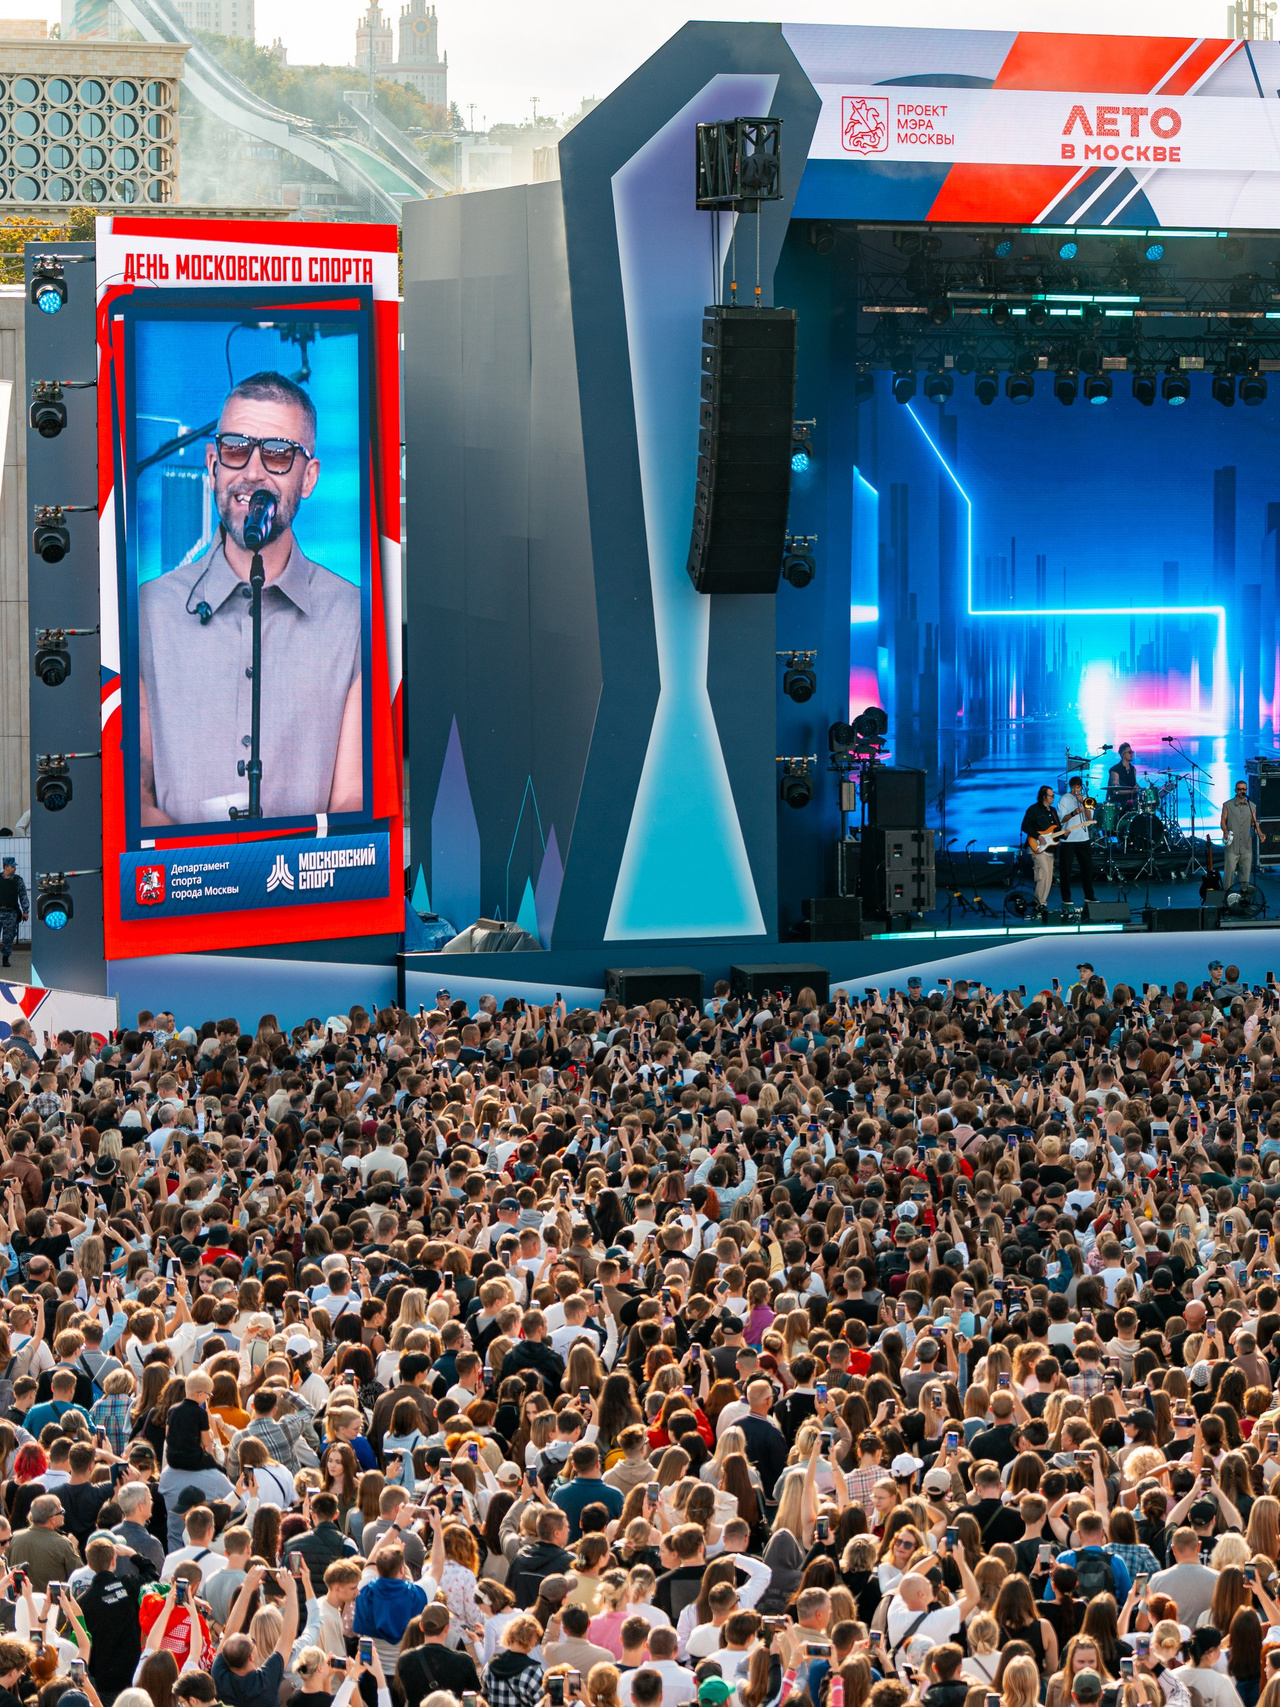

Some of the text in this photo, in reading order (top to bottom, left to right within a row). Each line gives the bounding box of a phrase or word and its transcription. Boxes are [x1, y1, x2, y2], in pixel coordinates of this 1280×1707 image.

[896, 104, 948, 118] ПРОЕКТ
[896, 119, 934, 132] МЭРА
[1061, 105, 1182, 139] ЛЕТО
[896, 132, 955, 145] МОСКВЫ
[1061, 144, 1181, 163] В МОСКВЕ
[123, 253, 373, 284] ДЕНЬ МОСКОВСКОГО СПОРТА
[298, 843, 376, 871] МОСКОВСКИЙ
[171, 861, 230, 876] Департамент
[171, 875, 202, 888] спорта
[298, 869, 336, 890] СПОРТ
[171, 884, 239, 900] города Москвы
